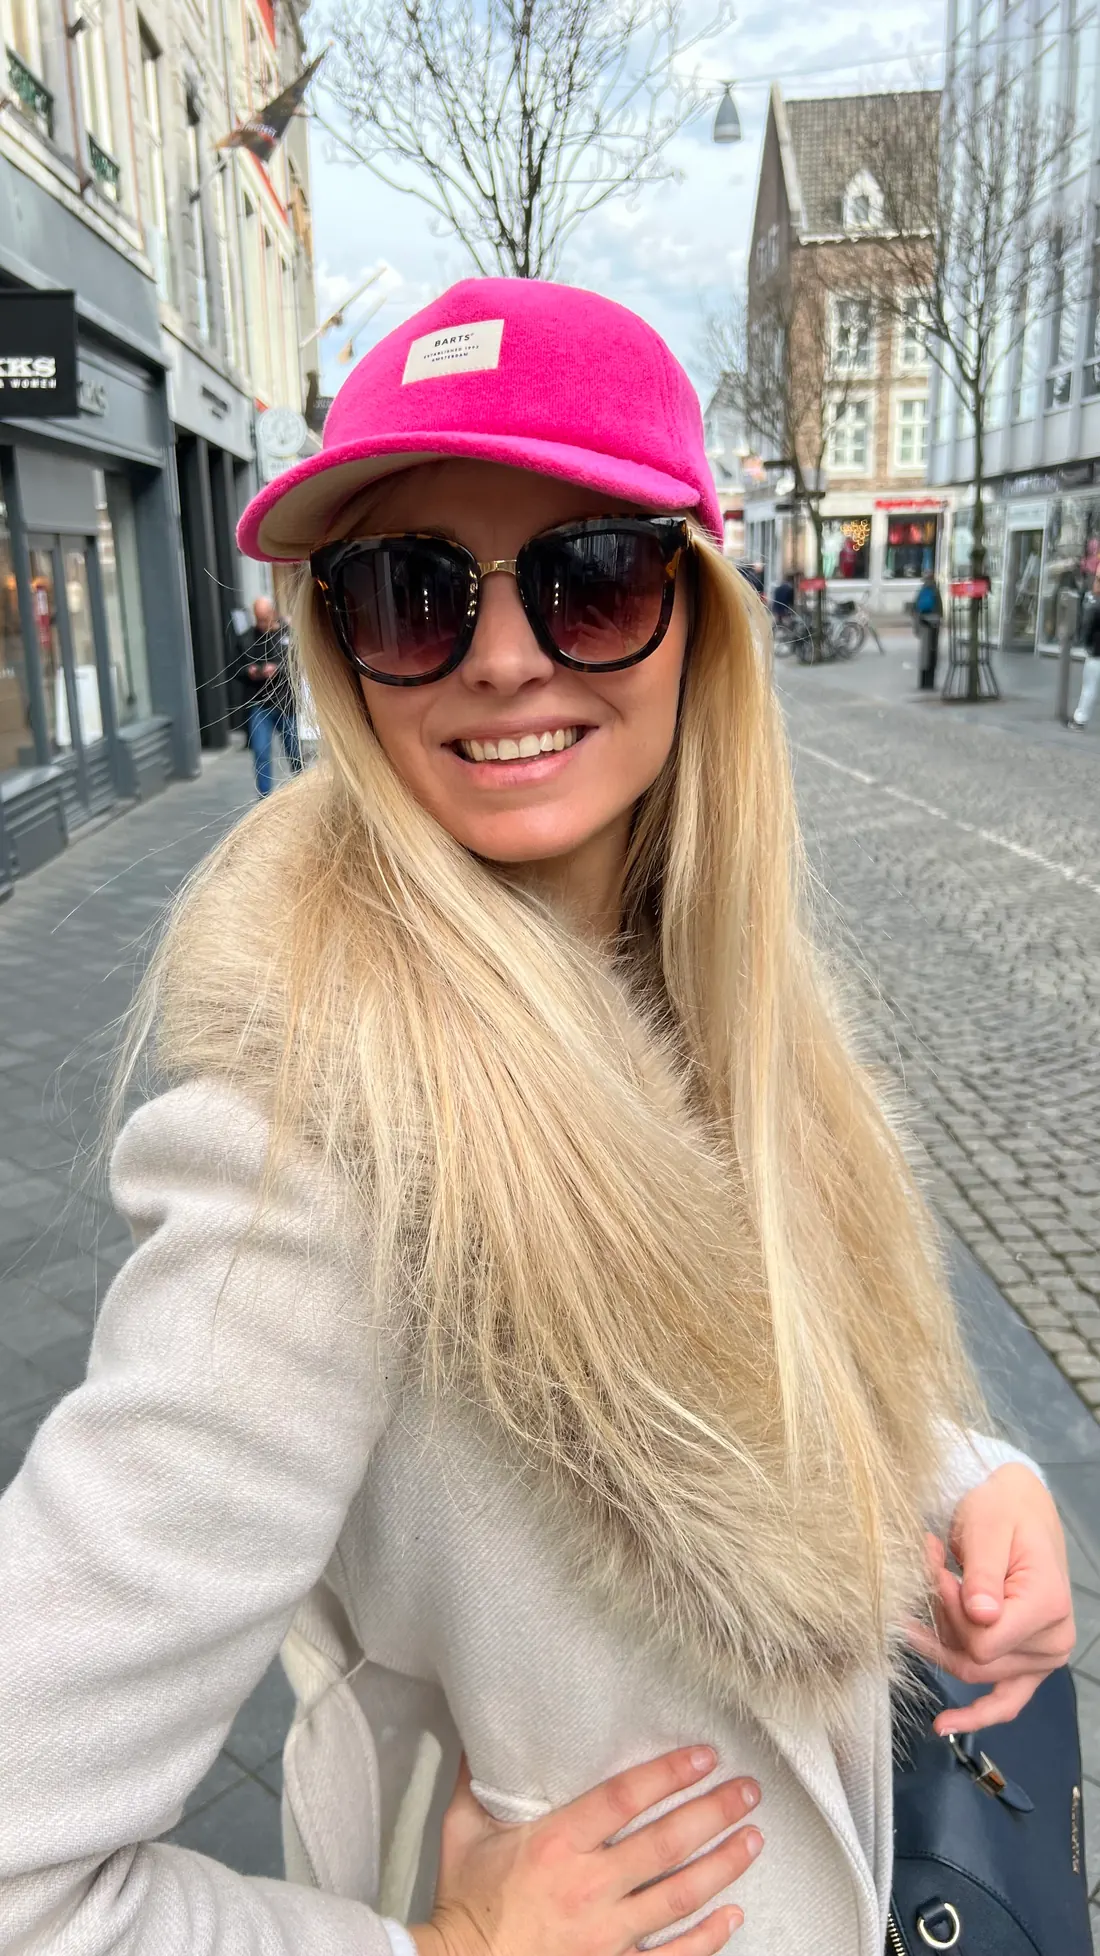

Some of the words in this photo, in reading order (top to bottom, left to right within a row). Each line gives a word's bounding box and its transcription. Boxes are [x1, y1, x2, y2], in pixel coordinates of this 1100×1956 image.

[423, 347, 462, 359] ESTABLISHED
[431, 352, 468, 362] AMSTERDAM
[10, 379, 57, 389] WOMEN
